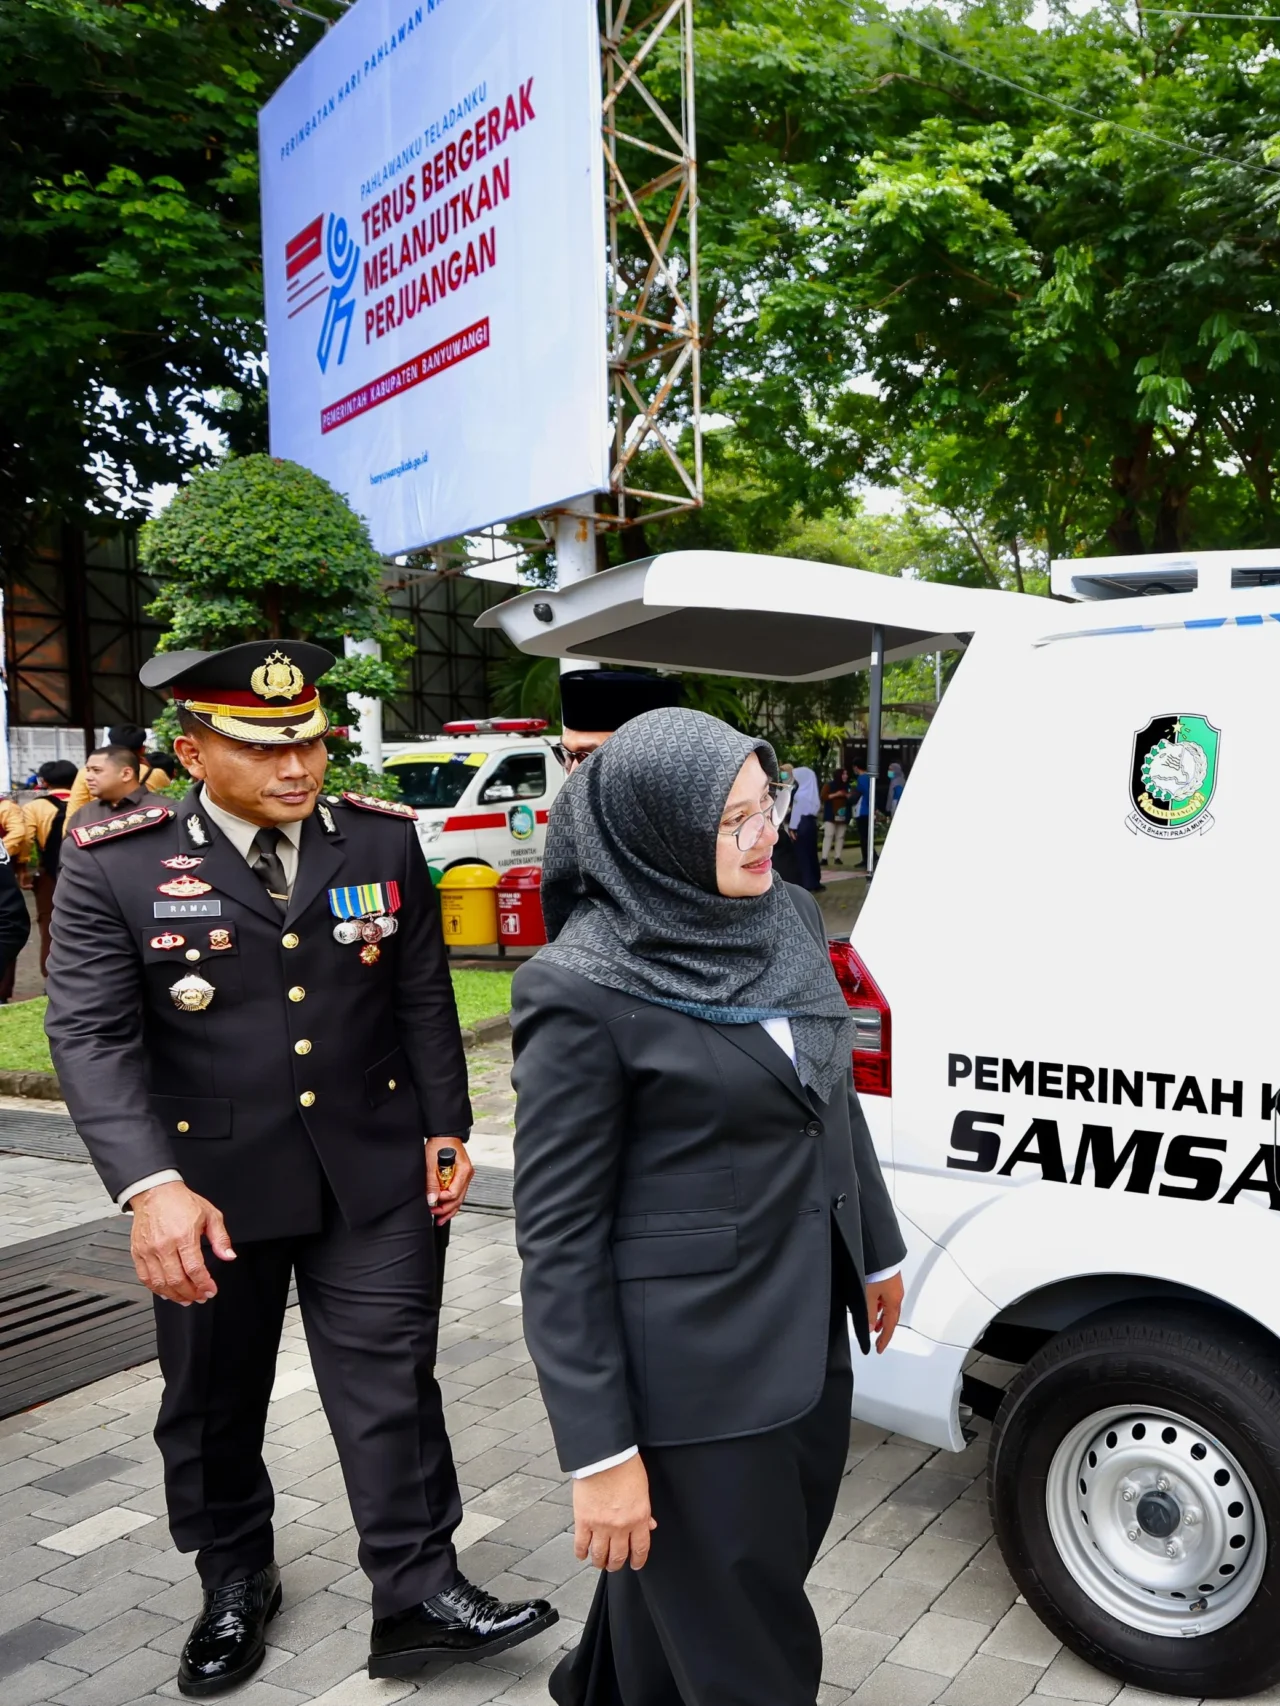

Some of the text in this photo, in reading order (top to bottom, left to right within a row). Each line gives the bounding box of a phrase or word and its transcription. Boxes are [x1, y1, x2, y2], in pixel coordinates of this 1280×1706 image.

[280, 95, 335, 161] PERINGATAN
[338, 69, 361, 103] HARI
[364, 6, 422, 77] PAHLAWAN
[360, 80, 487, 200] PAHLAWANKU TELADANKU
[362, 76, 536, 246] TERUS BERGERAK
[363, 157, 511, 296] MELANJUTKAN
[365, 226, 496, 345] PERJUANGAN
[322, 324, 488, 428] PEMERINTAH KABUPATEN BANYUWANGI
[370, 450, 428, 485] banyuwangikab.go.id
[1131, 813, 1209, 837] SATYA BHAKTI PRAJA MUKTI
[170, 905, 207, 913] RAMA
[948, 1053, 1243, 1119] PEMERINTAH
